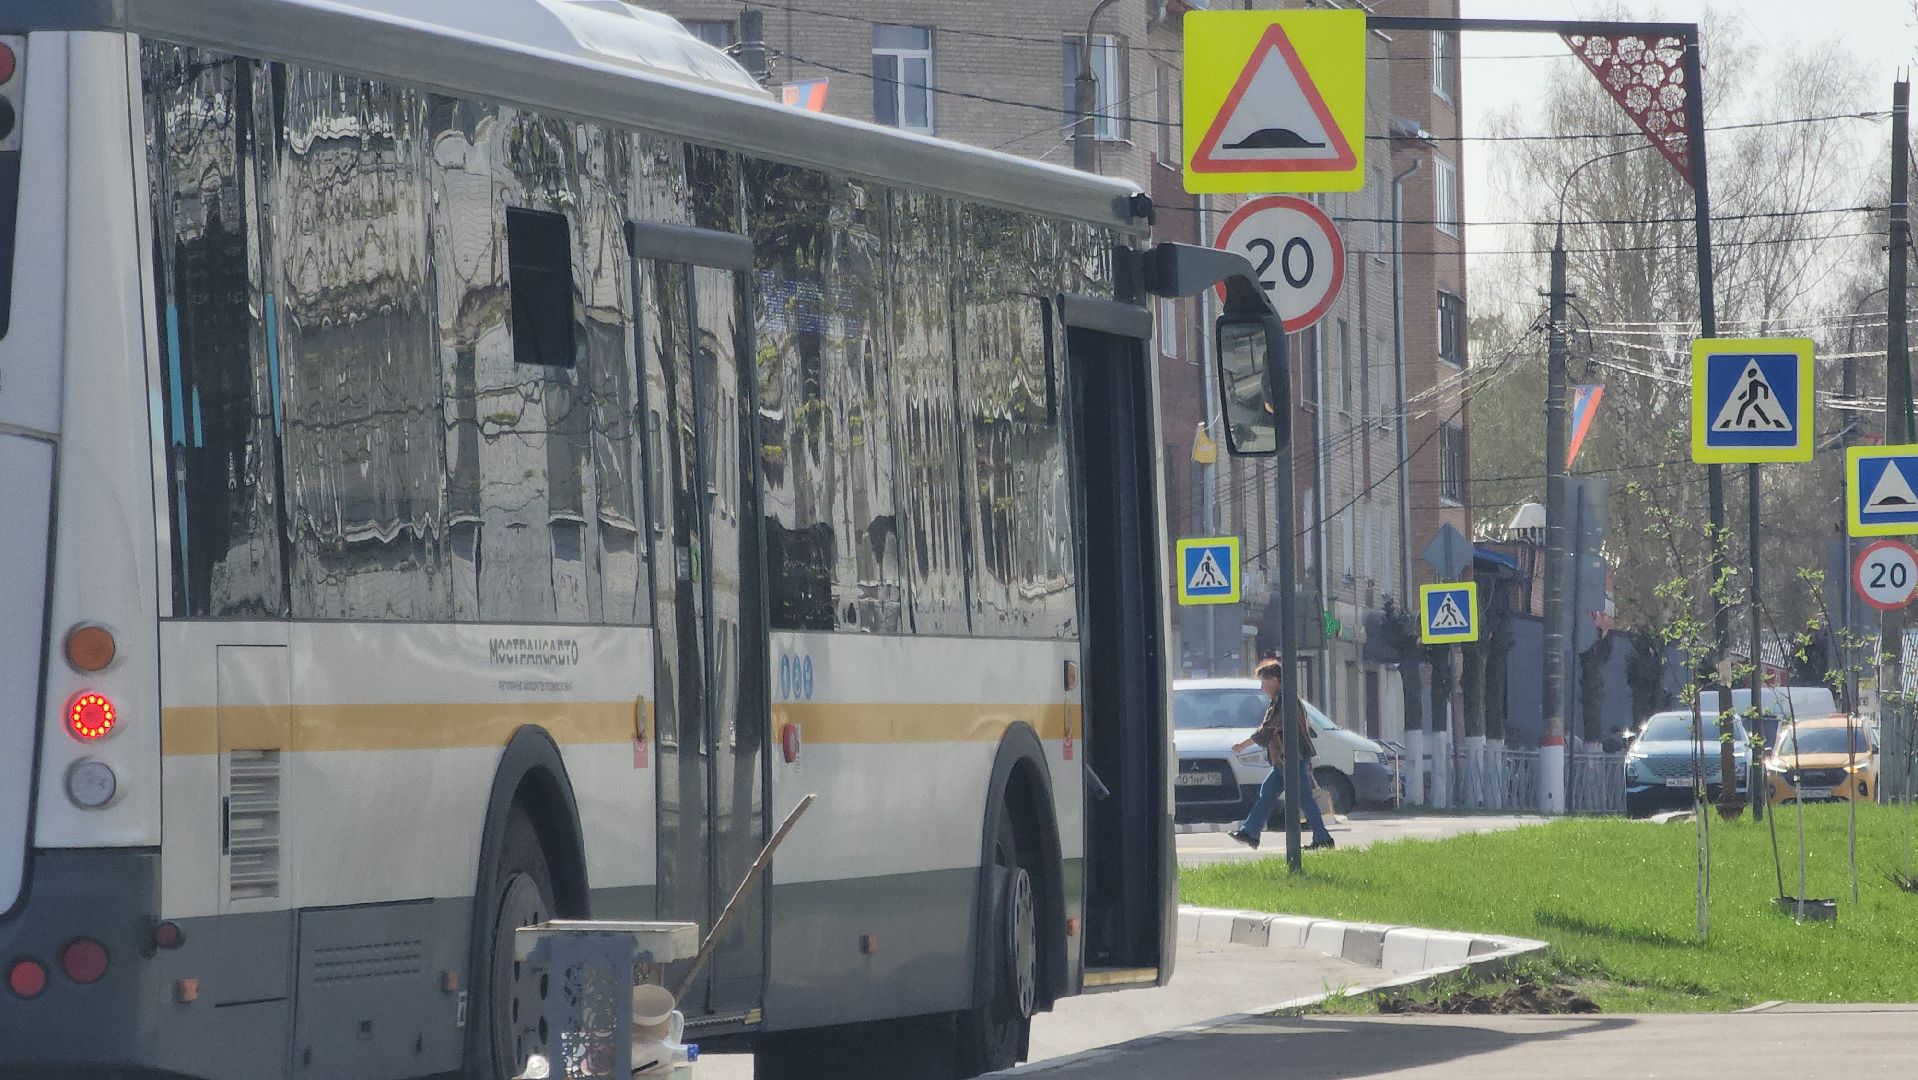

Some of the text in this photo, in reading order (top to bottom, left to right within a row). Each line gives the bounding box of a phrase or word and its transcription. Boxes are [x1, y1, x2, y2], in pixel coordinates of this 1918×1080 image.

[1245, 236, 1314, 290] 20
[1869, 562, 1907, 589] 20
[488, 638, 579, 666] МОСТРАНСАВТО
